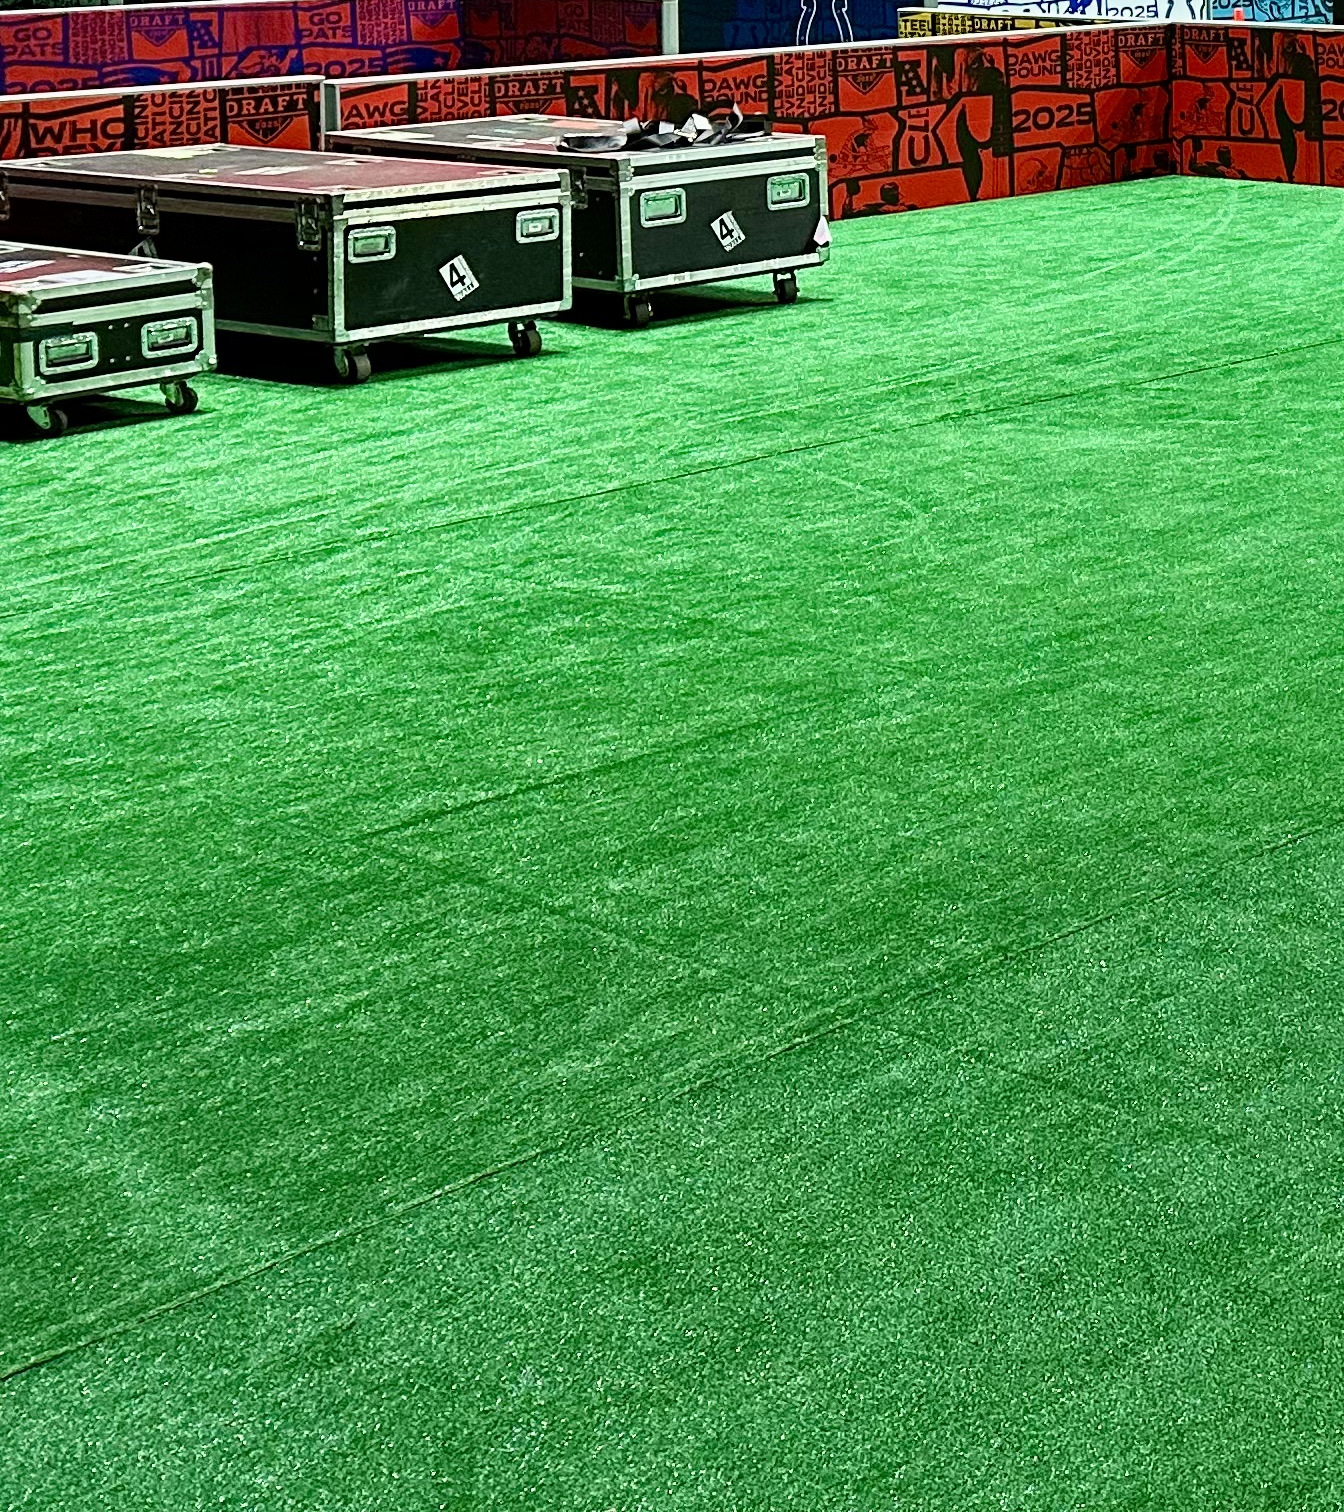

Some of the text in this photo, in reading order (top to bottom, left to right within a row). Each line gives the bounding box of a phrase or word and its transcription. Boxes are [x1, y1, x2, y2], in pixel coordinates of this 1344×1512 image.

[408, 0, 455, 11] DRAFT
[130, 13, 185, 27] DRAFT
[309, 12, 342, 26] GO
[974, 18, 1012, 31] DRAFT
[13, 27, 53, 39] GO
[1118, 33, 1166, 48] DRAFT
[1184, 28, 1226, 41] DRAFT
[836, 55, 893, 71] DRAFT
[1008, 50, 1060, 65] DAWG
[1009, 64, 1062, 79] POUND
[495, 80, 566, 98] DRAFT
[703, 75, 768, 93] DAWG
[227, 93, 308, 115] DRAFT
[1013, 103, 1092, 133] 2025
[31, 117, 124, 145] WHO
[908, 106, 931, 167] CLE
[449, 263, 467, 289] 4
